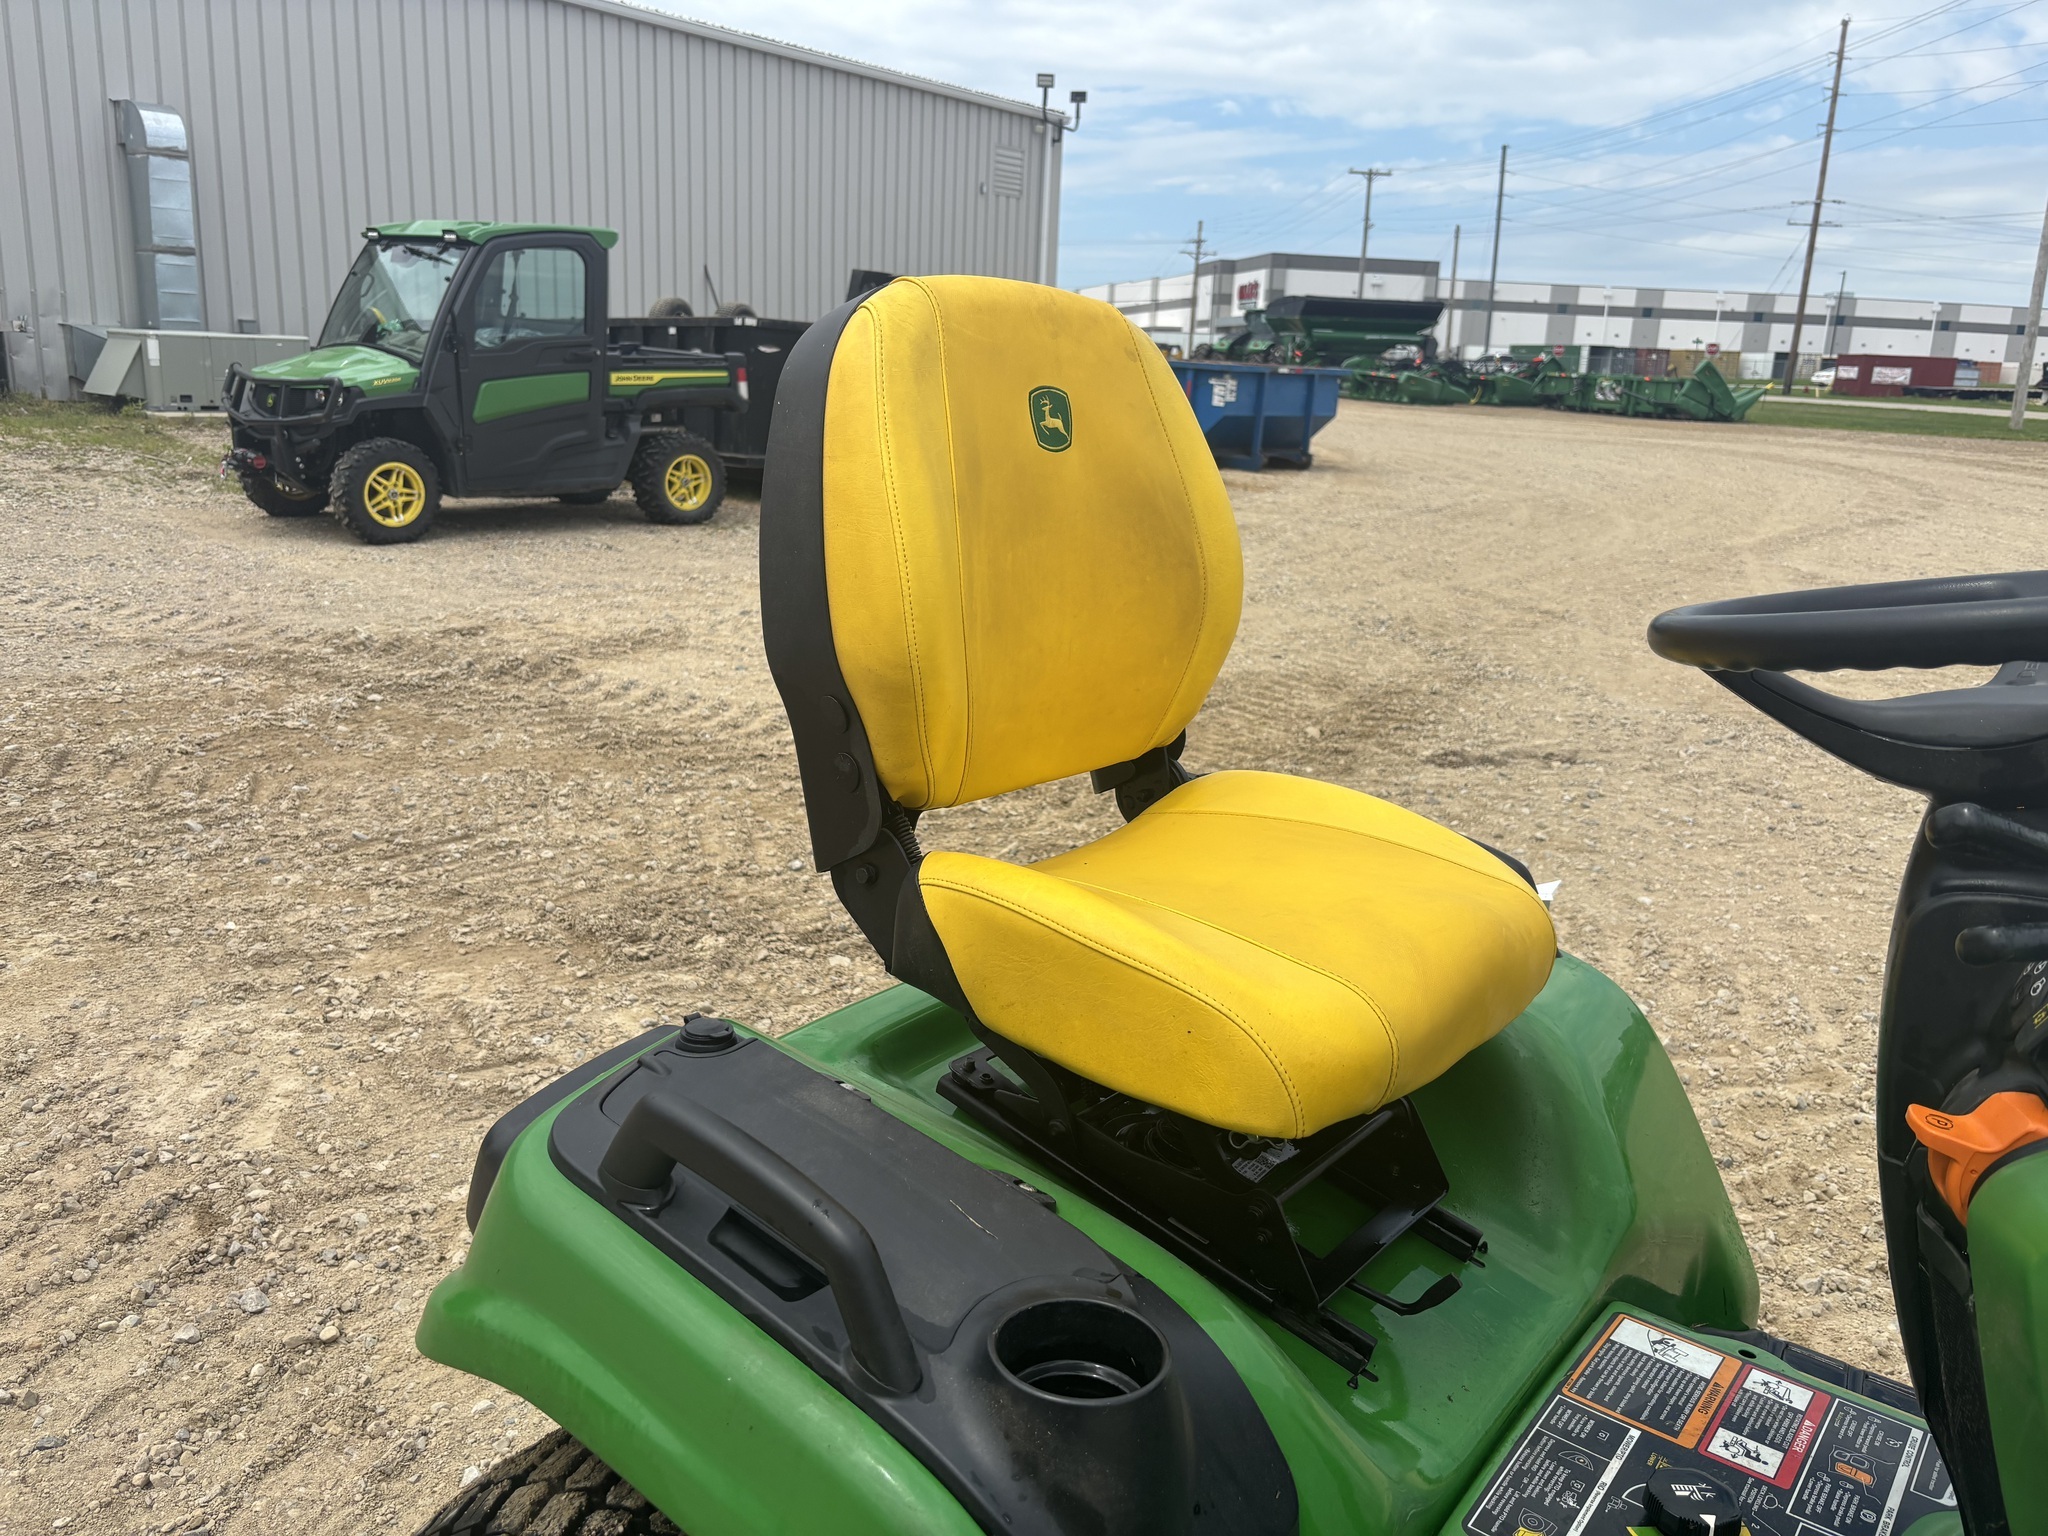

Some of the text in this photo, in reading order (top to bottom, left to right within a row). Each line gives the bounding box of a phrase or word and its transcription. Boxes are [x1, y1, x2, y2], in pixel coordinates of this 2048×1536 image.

[1689, 1389, 1701, 1403] SERIOUS
[1697, 1386, 1721, 1415] WARNING
[1682, 1402, 1693, 1414] INJURY
[1672, 1418, 1683, 1431] DEATH
[1791, 1425, 1813, 1453] DANGER
[1615, 1434, 1635, 1460] MOWER/PTO
[1901, 1435, 1918, 1468] CRUISE CONTROL
[1552, 1481, 1563, 1490] PTO
[1597, 1480, 1607, 1490] RIO
[1813, 1482, 1831, 1513] PARK BRAKE OFF
[1851, 1494, 1860, 1505] PARK
[1846, 1504, 1856, 1518] BRAKE
[1883, 1506, 1895, 1520] PARK
